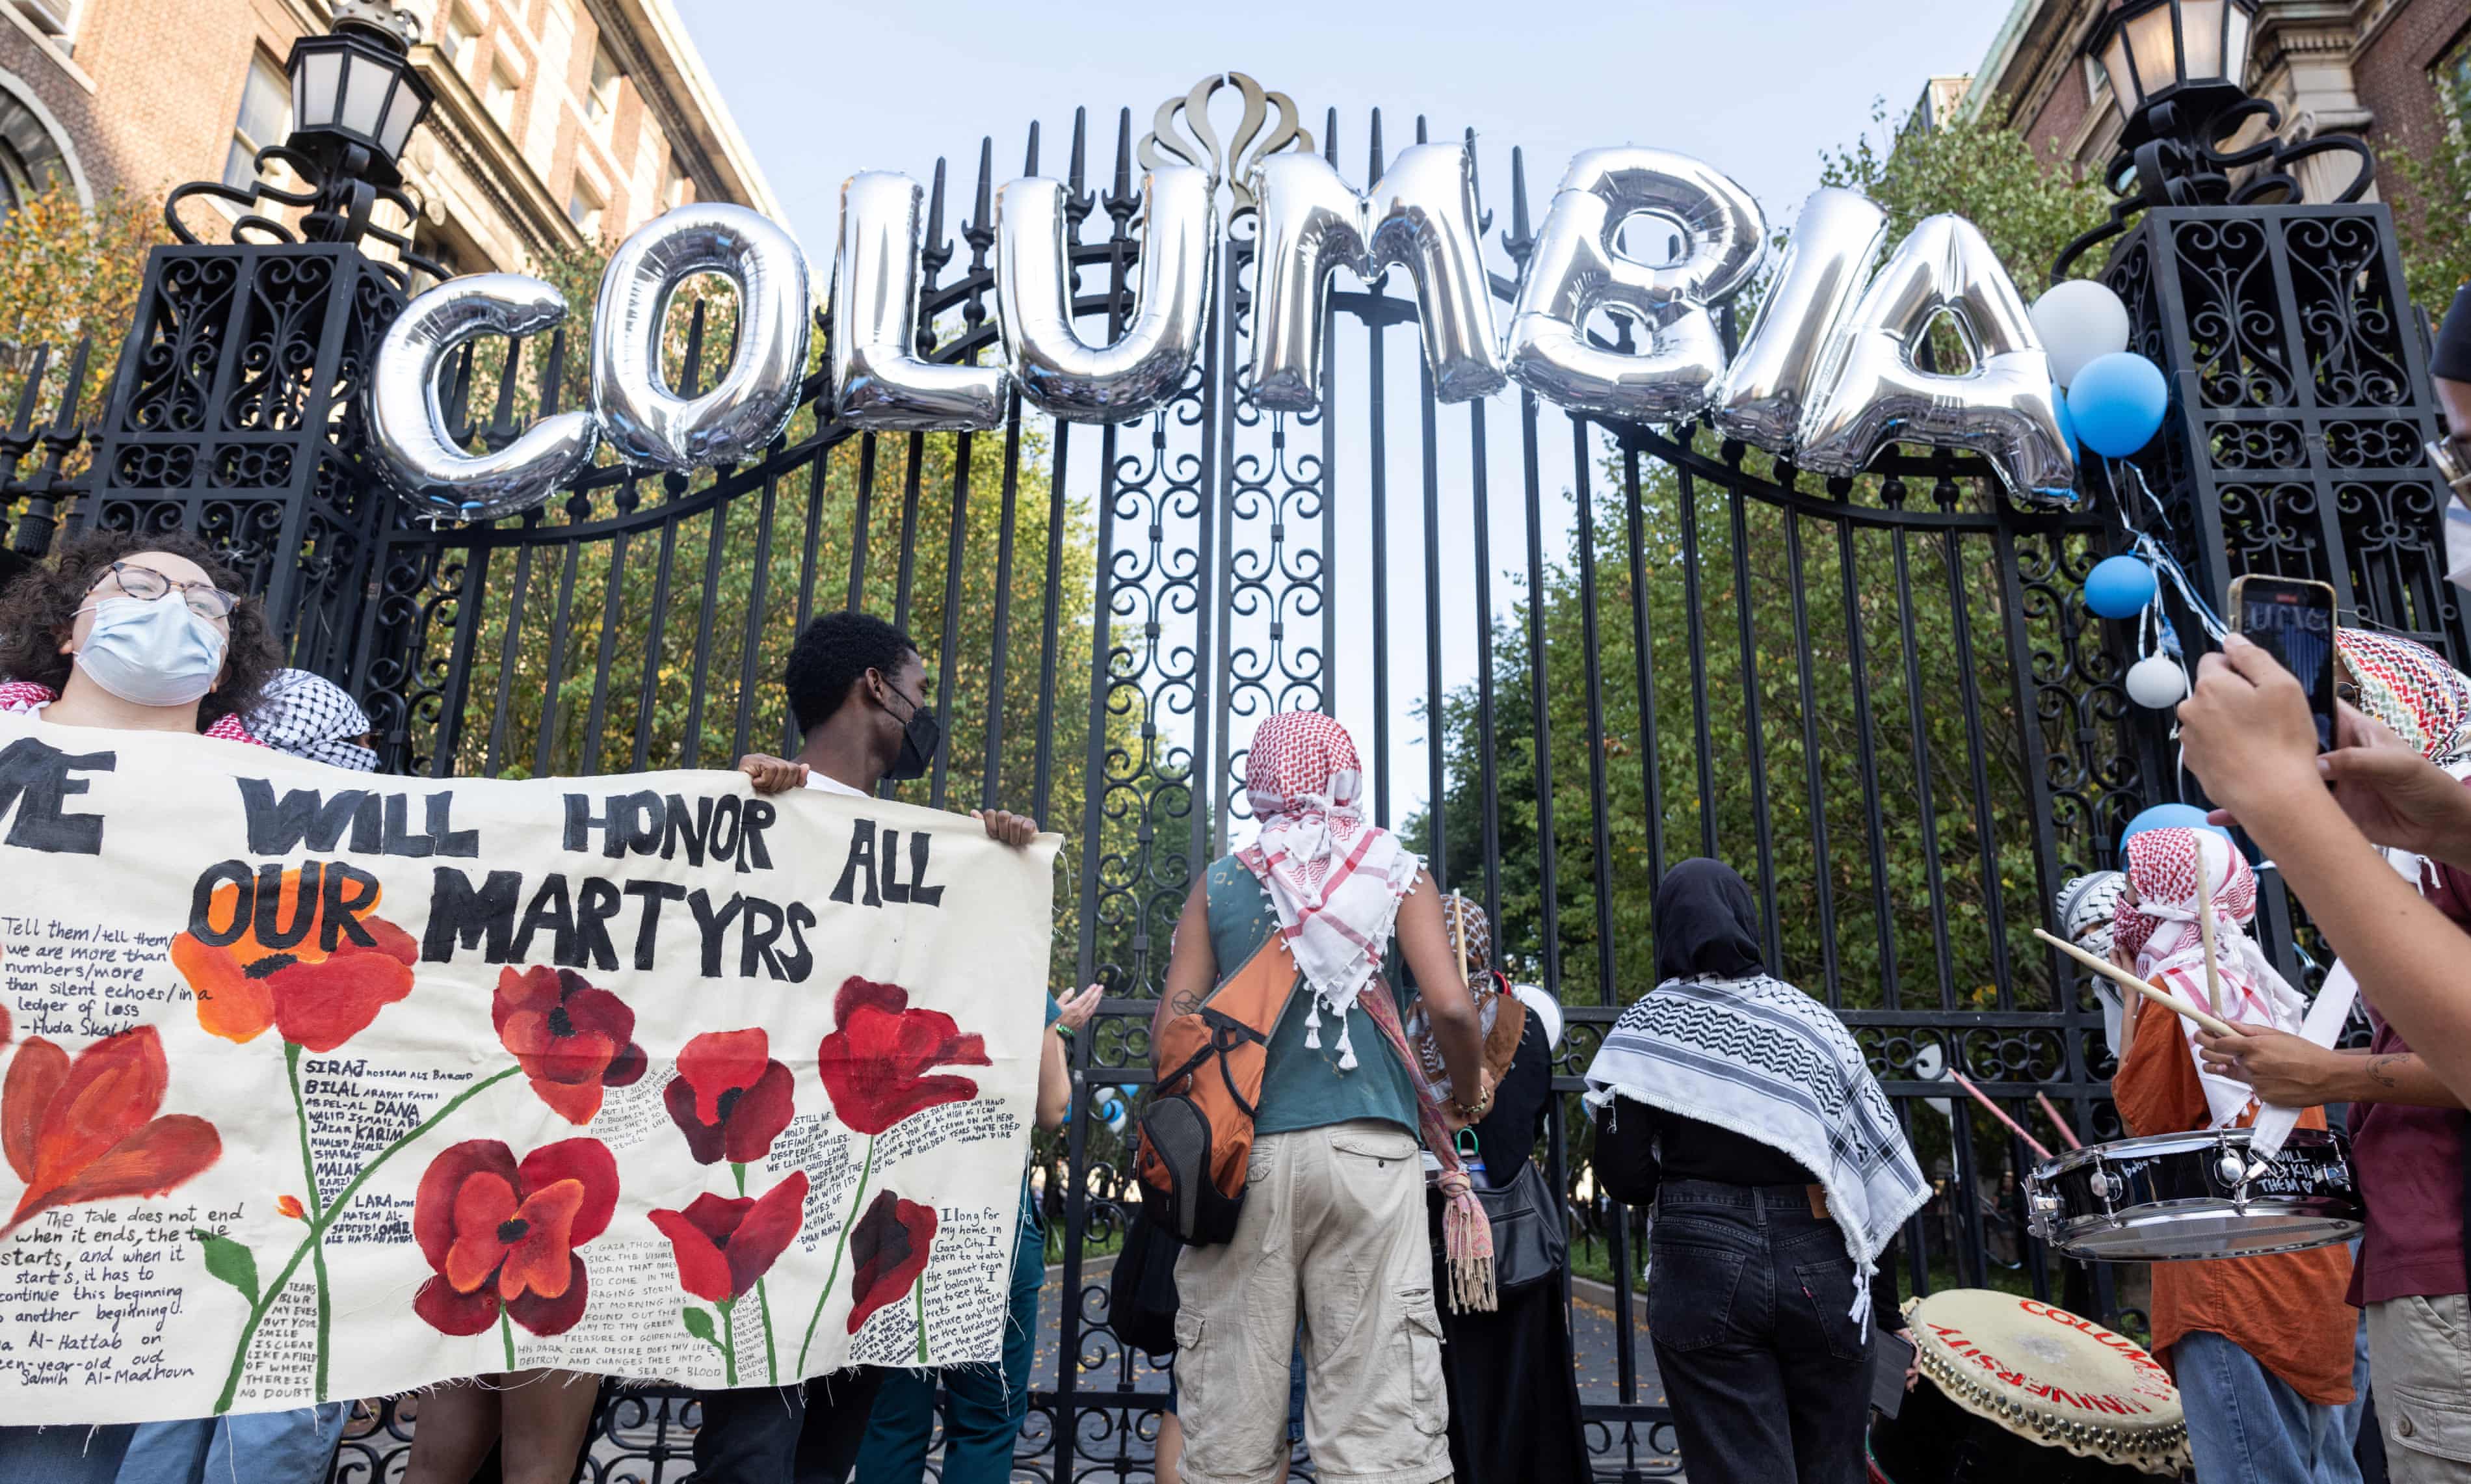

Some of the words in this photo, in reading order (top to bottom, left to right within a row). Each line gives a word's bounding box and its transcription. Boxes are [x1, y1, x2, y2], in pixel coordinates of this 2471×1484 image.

[368, 140, 2084, 524] COLUMBIA
[233, 775, 479, 858] WILL
[562, 789, 776, 874] HONOR
[829, 818, 946, 908] ALL
[1, 917, 40, 936] Tell
[187, 859, 382, 952] OUR
[421, 866, 817, 984] MARTYRS
[7, 944, 30, 957] we
[36, 946, 64, 960] are
[71, 947, 116, 963] more
[122, 949, 166, 962] than
[5, 977, 38, 992] than
[49, 981, 98, 996] silent
[197, 989, 213, 1000] a
[18, 996, 69, 1022] ledger
[78, 998, 96, 1020] of
[105, 1002, 139, 1016] loss
[306, 1059, 368, 1077] SIRAJ
[305, 1080, 360, 1097] BILAL
[374, 1100, 420, 1119] DANA
[793, 1114, 818, 1125] STILL
[356, 1124, 404, 1142] KARIM
[785, 1126, 804, 1139] HOLD
[315, 1162, 364, 1176] MALAK
[2257, 1178, 2299, 1191] THEM
[355, 1194, 392, 1208] LARA
[46, 1211, 73, 1228] The
[127, 1206, 163, 1223] does
[169, 1204, 198, 1223] not
[208, 1202, 244, 1222] end
[941, 1208, 952, 1222] I
[955, 1208, 979, 1227] long
[984, 1207, 999, 1219] for
[15, 1228, 62, 1242] when
[72, 1226, 87, 1243] it
[94, 1225, 143, 1247] ends,
[146, 1227, 179, 1242] the
[185, 1224, 231, 1241] tale
[941, 1227, 955, 1241] my
[960, 1226, 987, 1234] home
[936, 1240, 962, 1252] Gaza
[987, 1236, 997, 1246] I
[1, 1247, 72, 1269] starts,
[79, 1245, 113, 1262] and
[123, 1249, 161, 1262] when
[170, 1243, 185, 1262] it
[931, 1254, 955, 1269] yearn
[960, 1251, 970, 1260] to
[977, 1250, 1005, 1260] watch
[85, 1267, 96, 1281] it
[103, 1267, 129, 1281] has
[139, 1265, 154, 1280] to
[629, 1263, 653, 1271] THAT
[927, 1271, 942, 1282] the
[947, 1263, 977, 1276] sunset
[925, 1284, 940, 1294] our
[987, 1271, 996, 1282] I
[73, 1286, 105, 1299] this
[114, 1286, 183, 1314] beginning
[591, 1289, 635, 1299] RAGING
[924, 1297, 942, 1311] long
[975, 1286, 991, 1295] the
[957, 1297, 973, 1309] and
[15, 1308, 79, 1321] another
[272, 1306, 289, 1314] MY
[929, 1316, 962, 1332] nature
[965, 1308, 982, 1321] and
[141, 1334, 163, 1344] on
[2019, 1300, 2173, 1401] COLUM
[246, 1362, 265, 1370] OF
[687, 1367, 721, 1377] BLOOD
[264, 1388, 312, 1399] DOUBT
